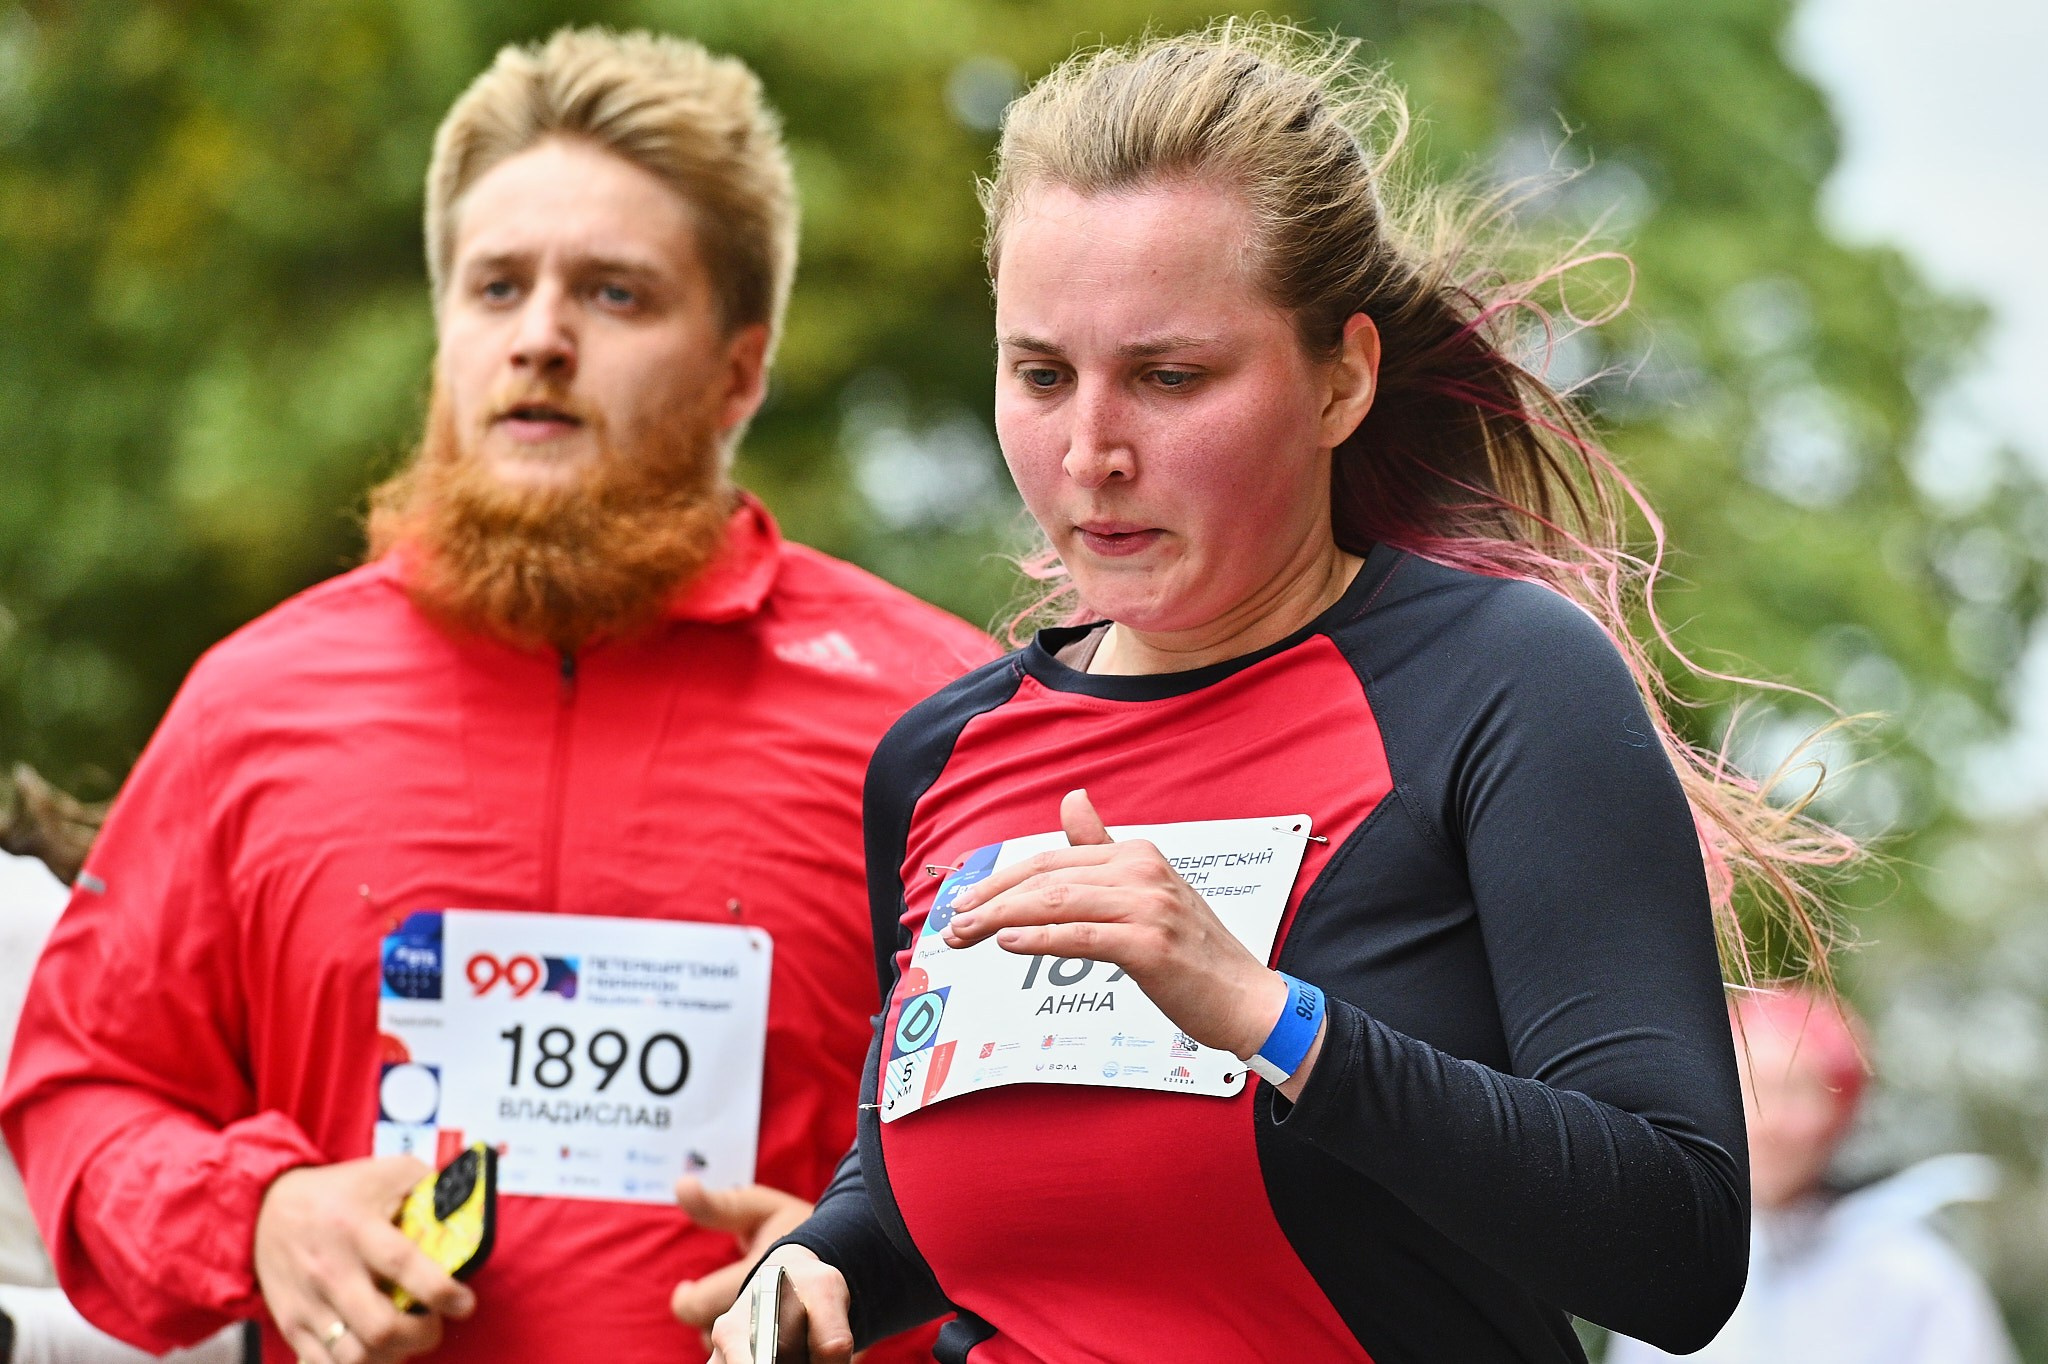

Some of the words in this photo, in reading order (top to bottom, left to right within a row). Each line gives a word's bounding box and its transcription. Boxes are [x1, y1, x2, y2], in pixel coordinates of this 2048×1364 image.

[1168, 848, 1274, 869] РБУРГСКИЙ
[1194, 885, 1261, 897] ТЕРБУРГ
[465, 953, 540, 998] 99
[1035, 991, 1114, 1016] АННА
[501, 1023, 690, 1097] 1890
[903, 1062, 914, 1083] 5
[499, 1098, 672, 1130] ВЛАДИСЛАВ
